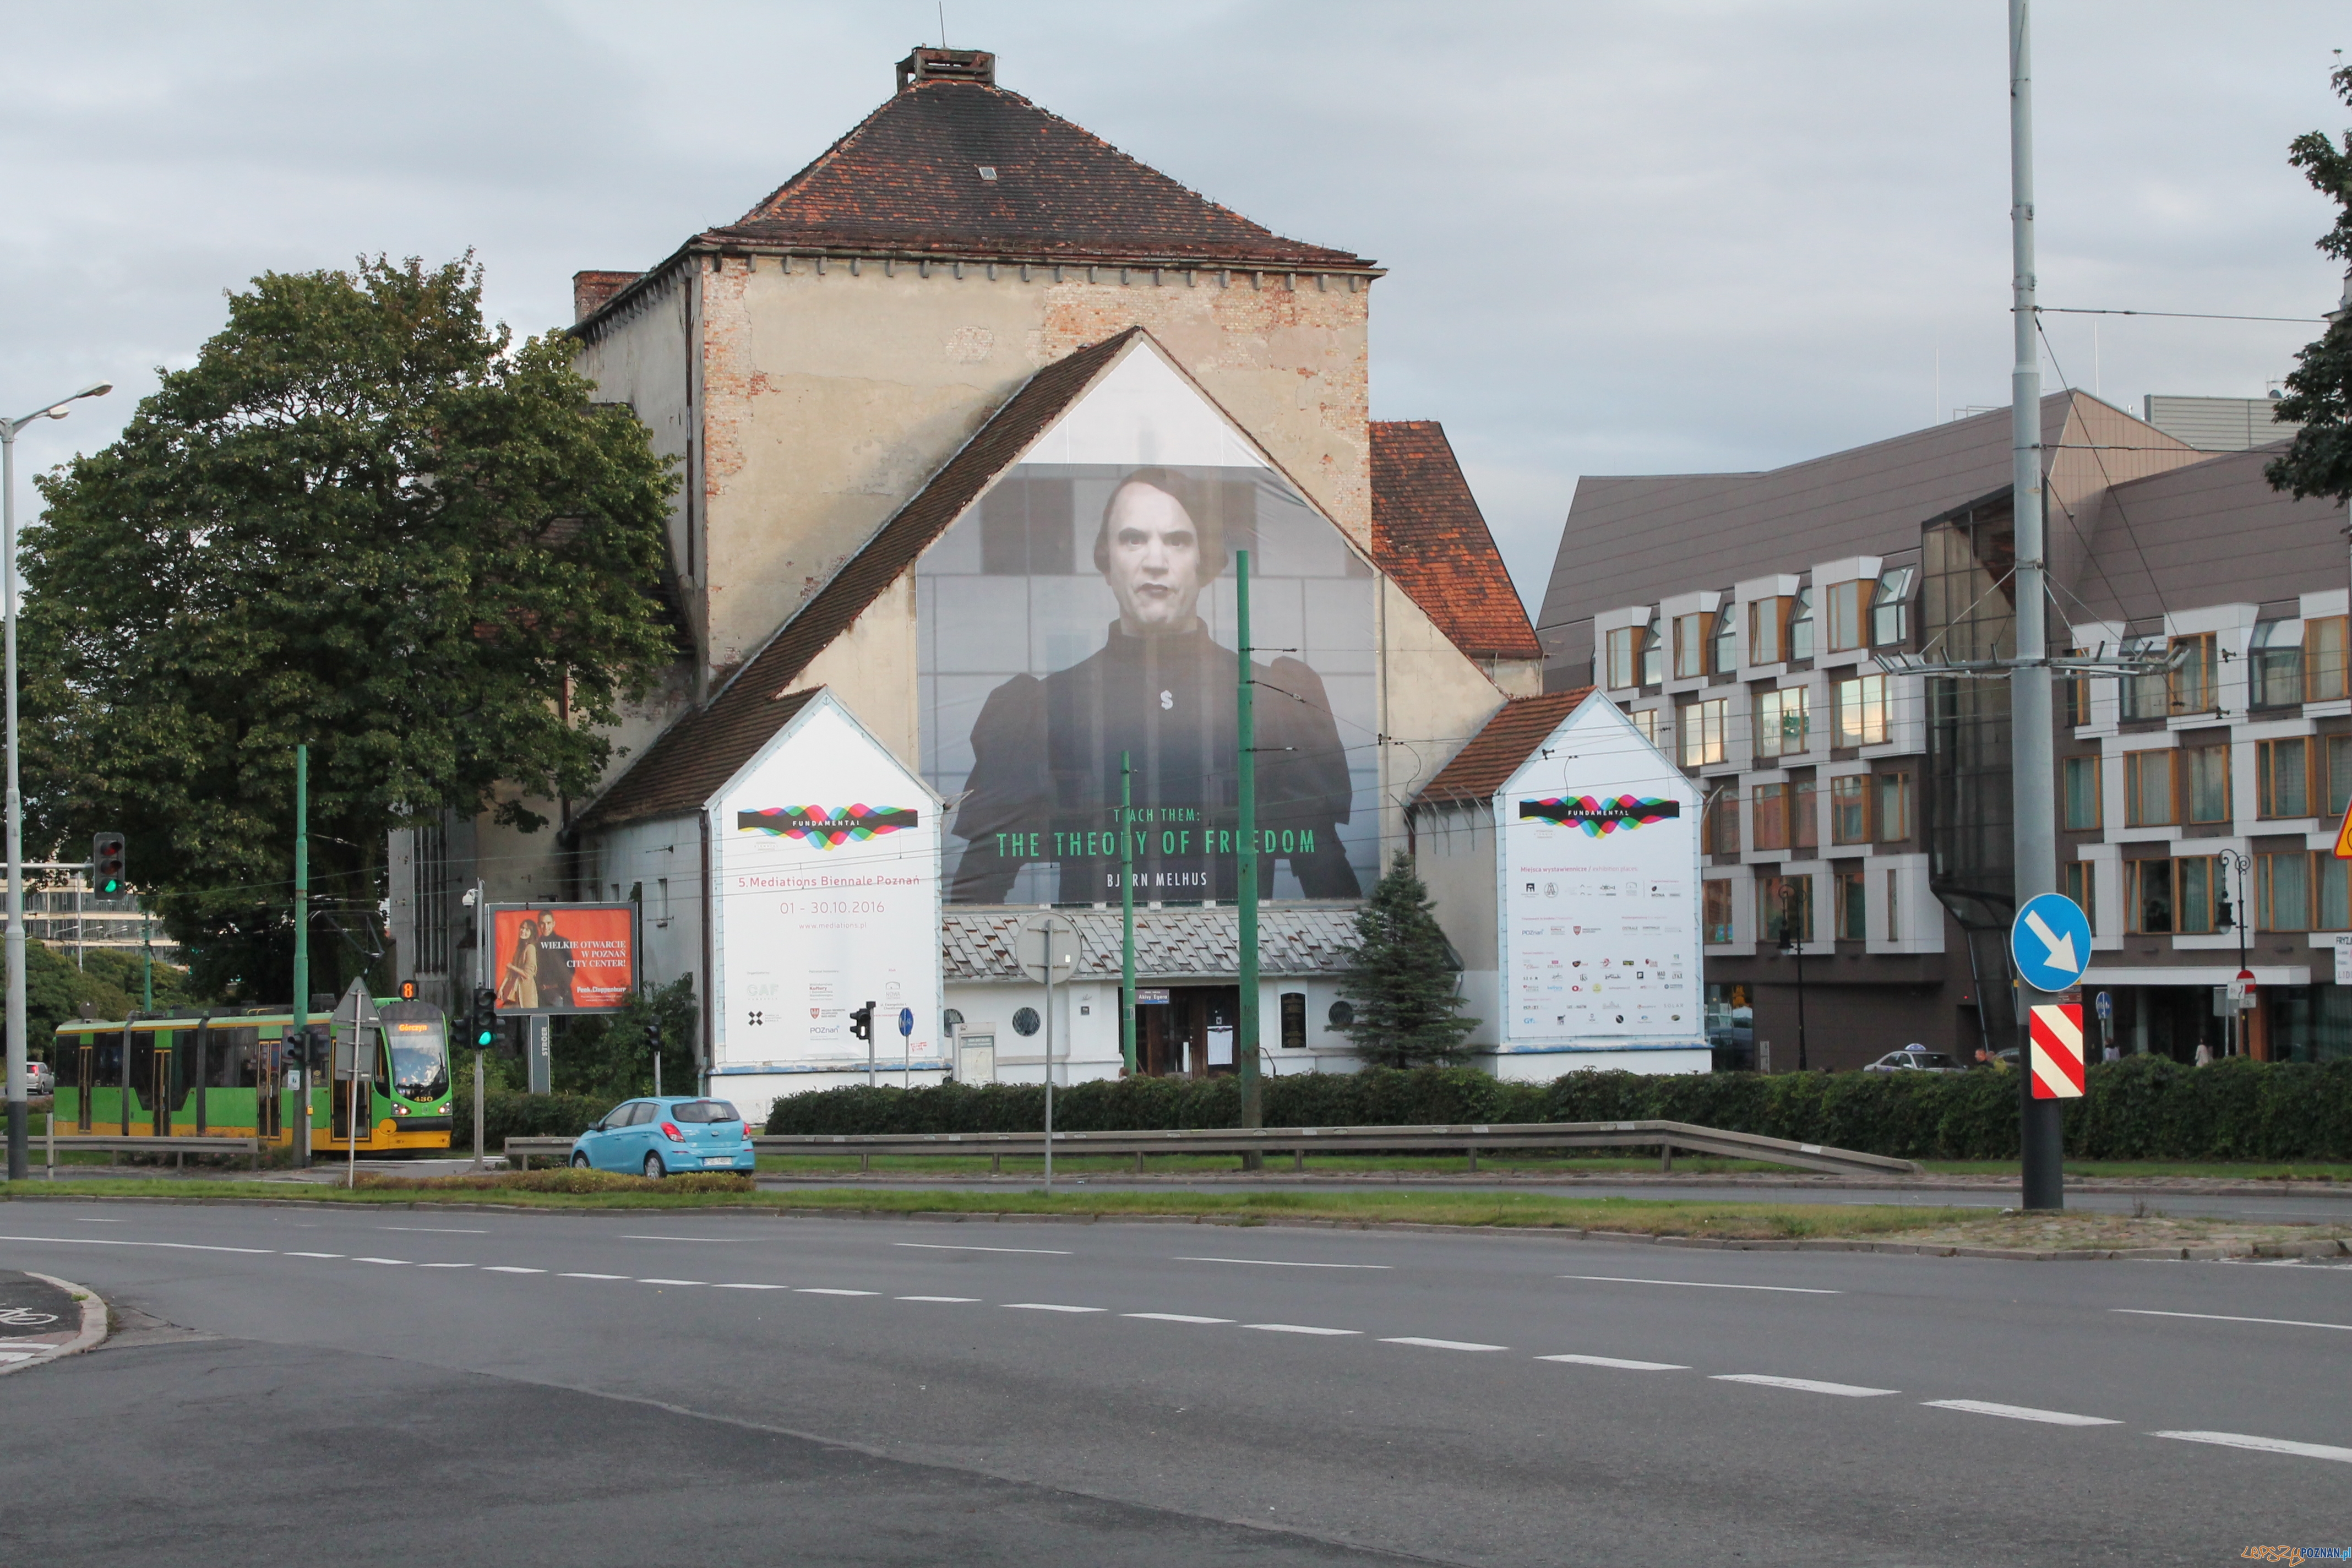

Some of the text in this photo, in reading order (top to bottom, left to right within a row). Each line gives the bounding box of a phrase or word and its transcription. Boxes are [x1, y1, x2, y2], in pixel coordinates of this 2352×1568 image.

[1114, 808, 1200, 822] TACH THEM:
[997, 832, 1040, 857] THE
[1054, 830, 1147, 857] THEOY
[1162, 830, 1190, 854] OF
[821, 875, 873, 886] Biennale
[876, 874, 920, 885] Poznań
[1107, 872, 1207, 888] BJRN MELHUS
[780, 902, 795, 914] 01
[810, 901, 885, 914] 30.10.2016
[540, 940, 626, 949] WIELKIE OTWARCIE
[591, 948, 626, 958] POZNAŃ
[566, 959, 626, 968] CITY CENTER!
[403, 983, 413, 998] 8
